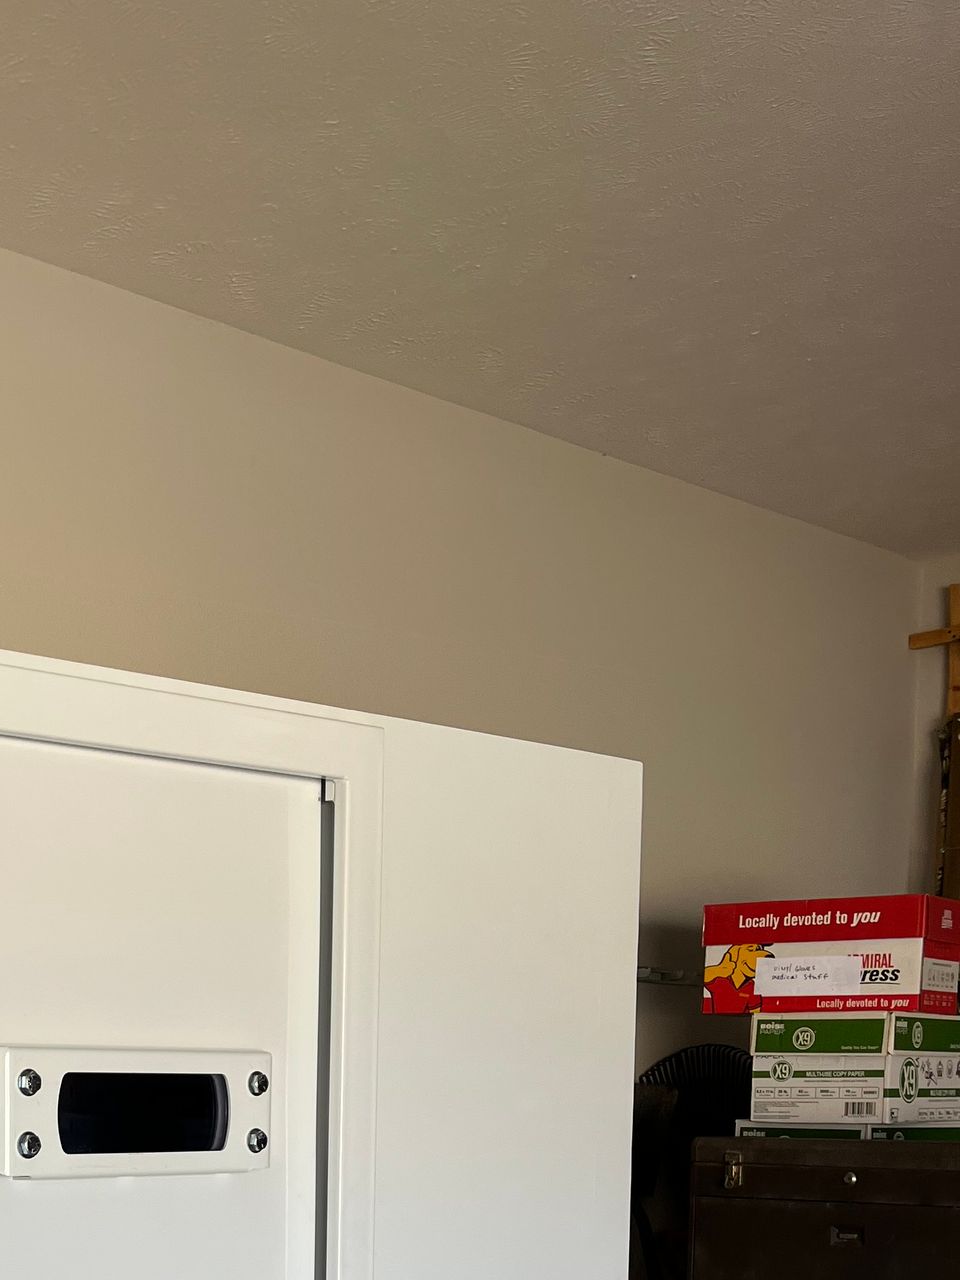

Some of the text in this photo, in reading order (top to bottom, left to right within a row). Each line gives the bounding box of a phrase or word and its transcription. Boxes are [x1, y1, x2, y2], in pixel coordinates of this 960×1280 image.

[739, 911, 881, 930] Locally devoted to you
[847, 953, 894, 968] MIRAL
[816, 998, 910, 1010] Locally devoted to you
[797, 1032, 811, 1045] X9
[775, 1063, 789, 1079] X9
[903, 1065, 916, 1096] X9
